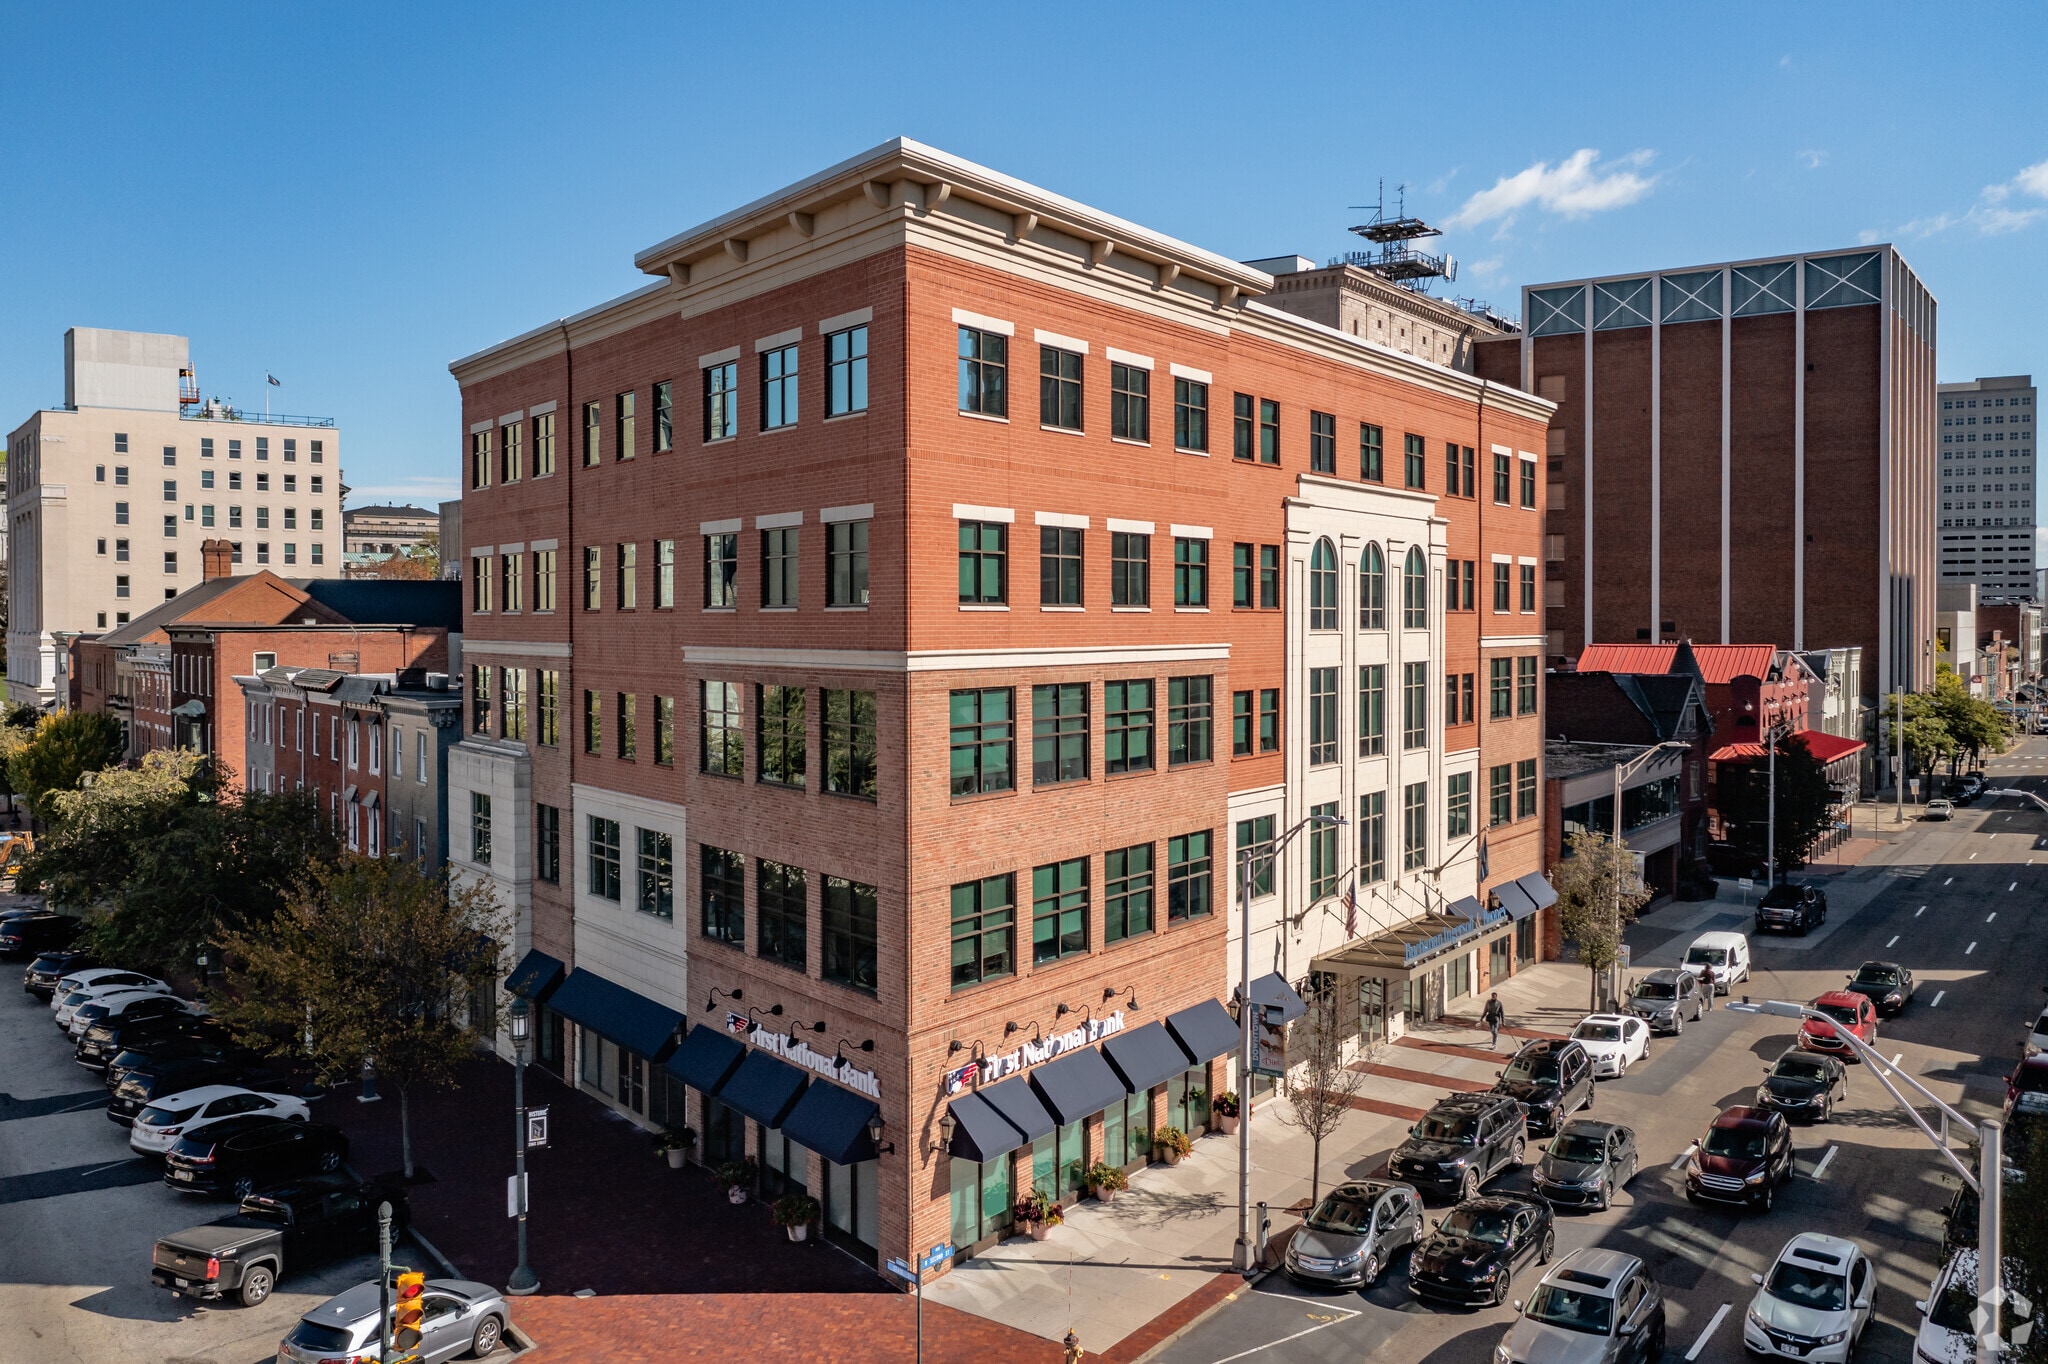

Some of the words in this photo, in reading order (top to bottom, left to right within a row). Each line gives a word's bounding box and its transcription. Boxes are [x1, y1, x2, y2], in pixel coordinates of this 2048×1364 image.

[1405, 933, 1443, 961] Buchanan
[1443, 915, 1475, 943] Ingersoll
[749, 1021, 780, 1052] First
[779, 1033, 839, 1080] National
[839, 1060, 881, 1098] Bank
[984, 1050, 1021, 1083] First
[1023, 1027, 1087, 1067] National
[1089, 1010, 1126, 1043] Bank
[930, 1253, 943, 1264] SECOND
